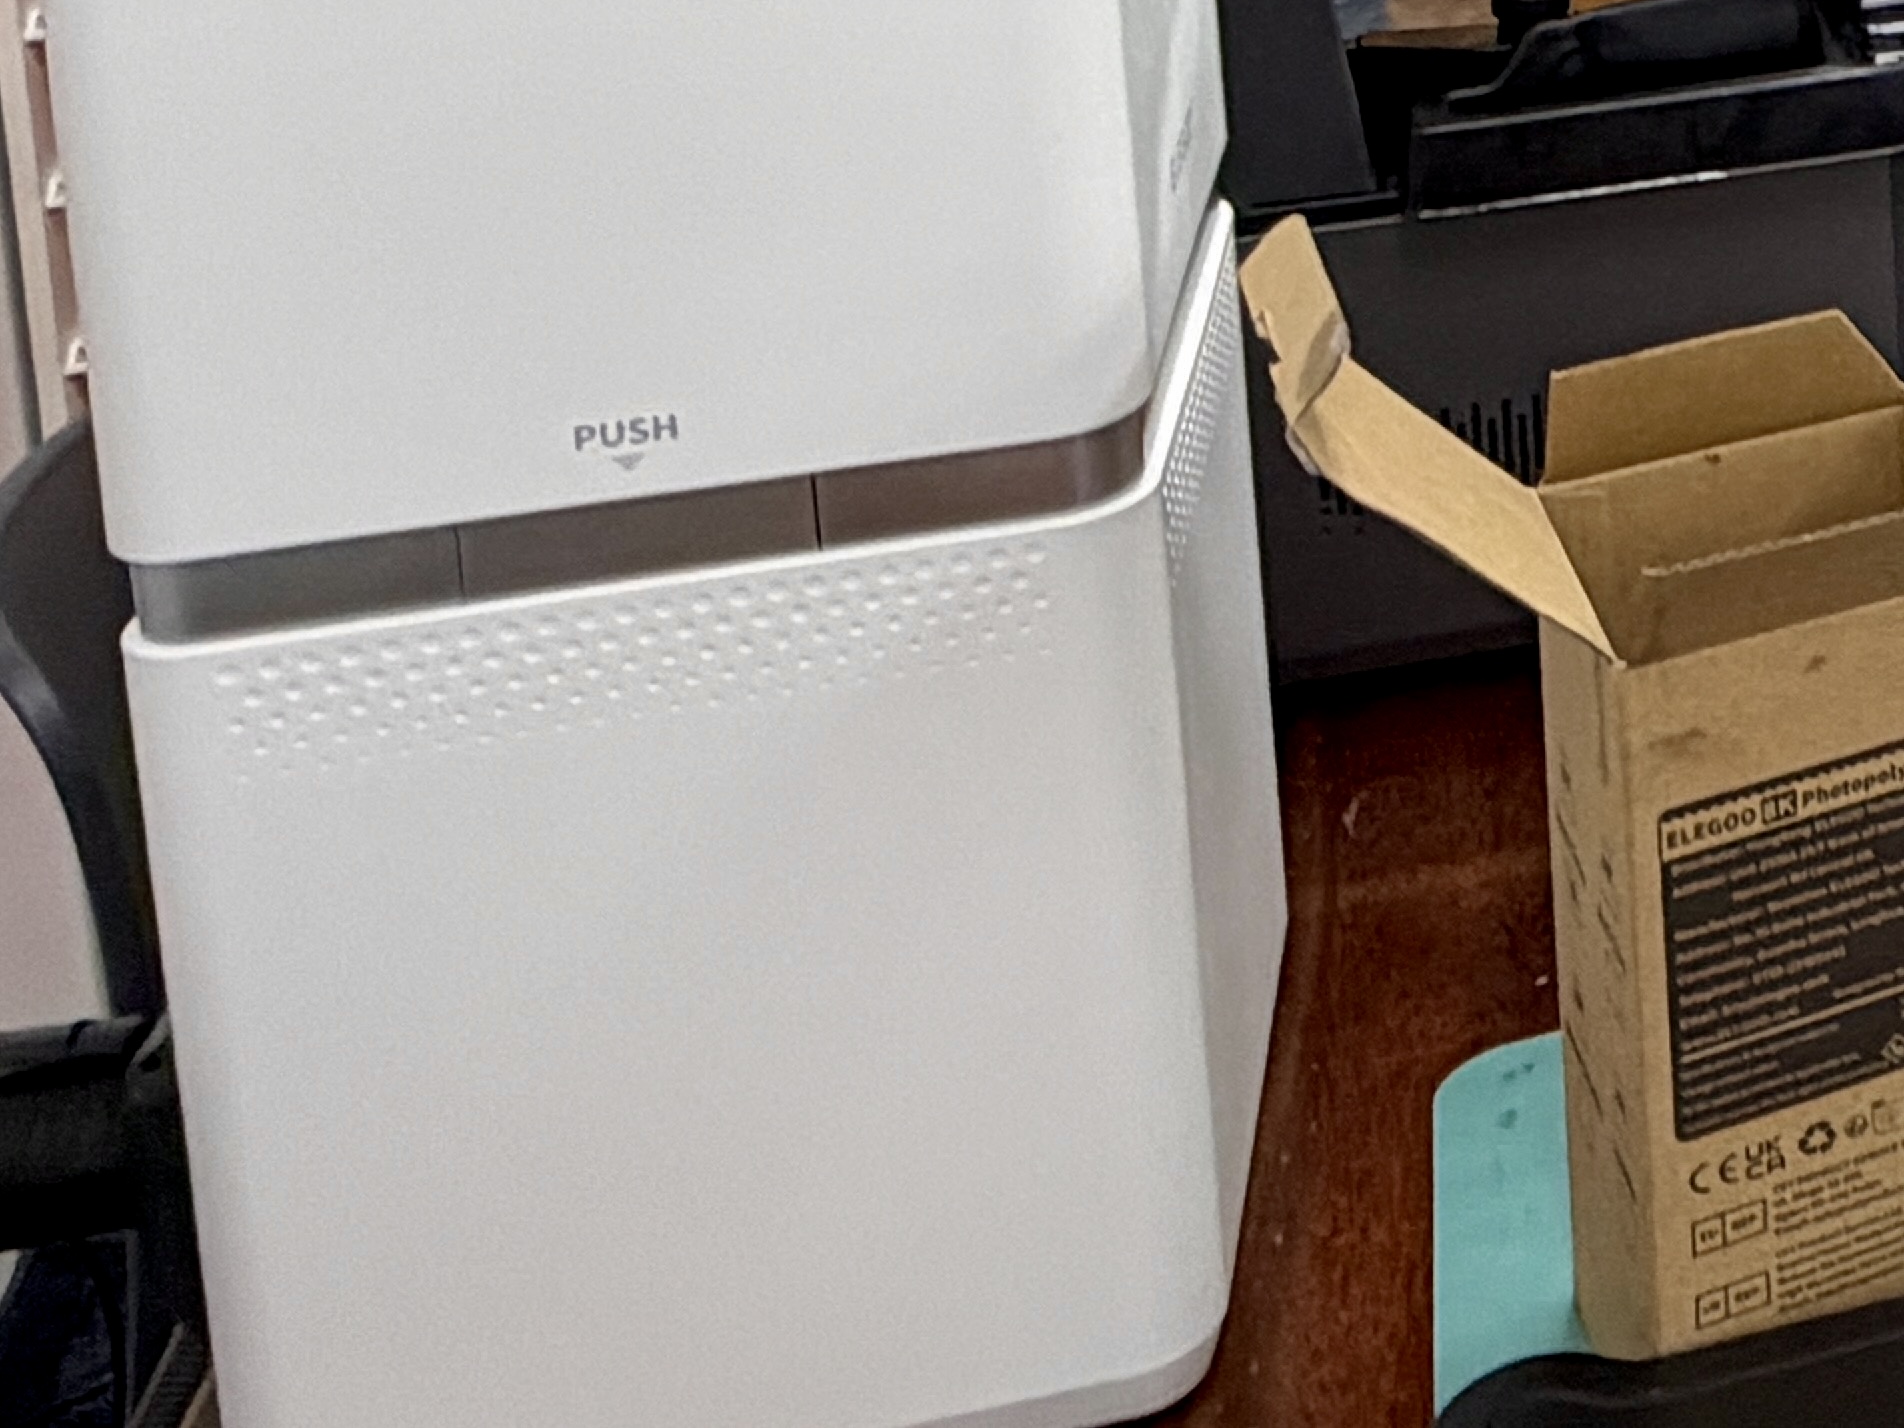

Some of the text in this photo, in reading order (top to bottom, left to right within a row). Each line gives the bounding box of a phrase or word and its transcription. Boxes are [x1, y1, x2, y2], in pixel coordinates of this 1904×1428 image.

[573, 413, 678, 451] PUSH
[1665, 808, 1758, 850] ELEGOO
[1689, 1152, 1740, 1195] CE
